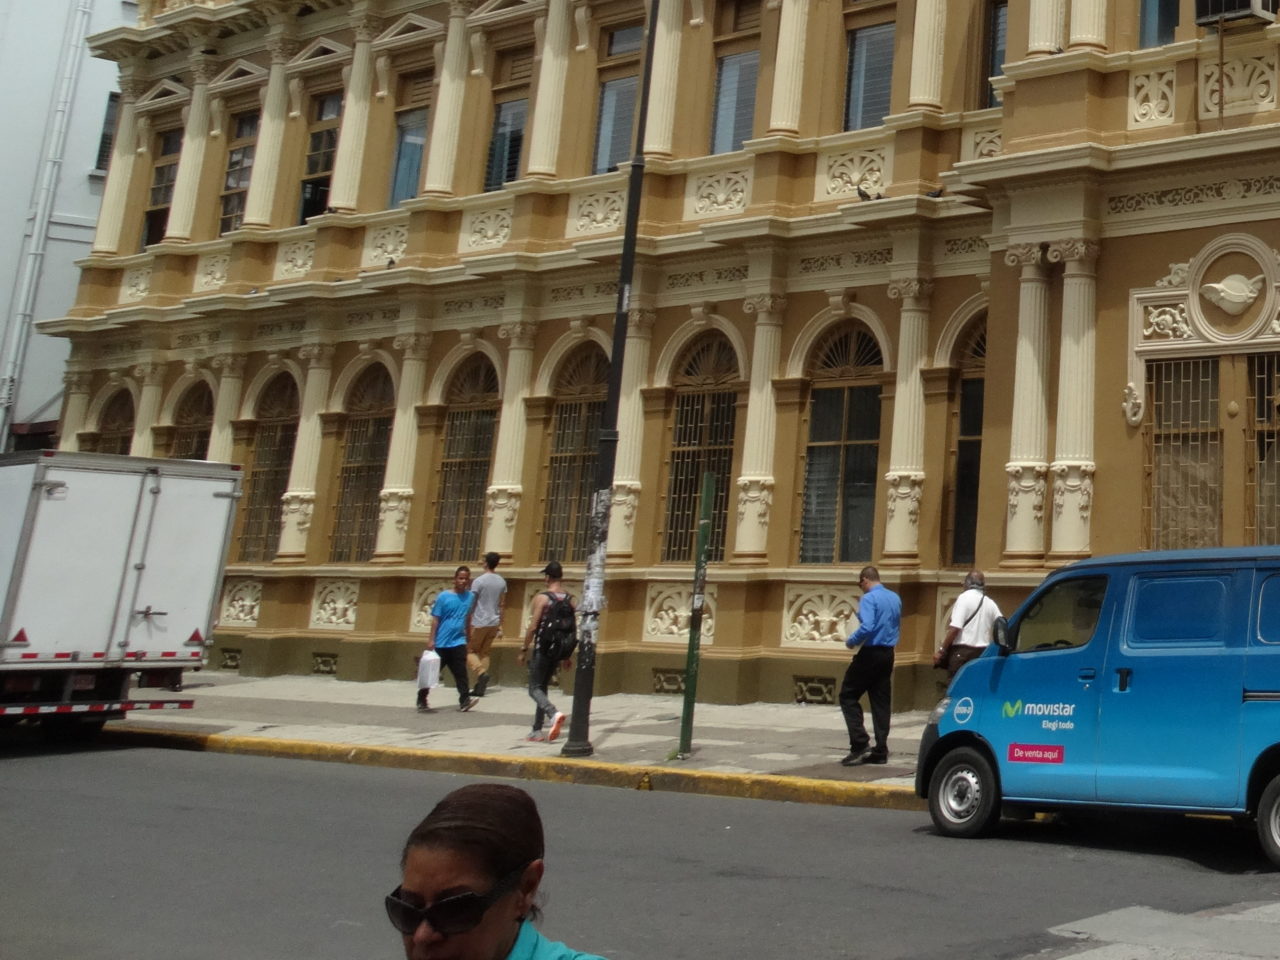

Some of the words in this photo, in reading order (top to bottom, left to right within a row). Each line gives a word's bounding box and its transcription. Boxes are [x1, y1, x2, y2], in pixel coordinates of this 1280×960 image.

[1024, 702, 1076, 716] movistar
[1059, 720, 1074, 729] todo
[1014, 748, 1024, 757] De
[1025, 750, 1042, 758] venta
